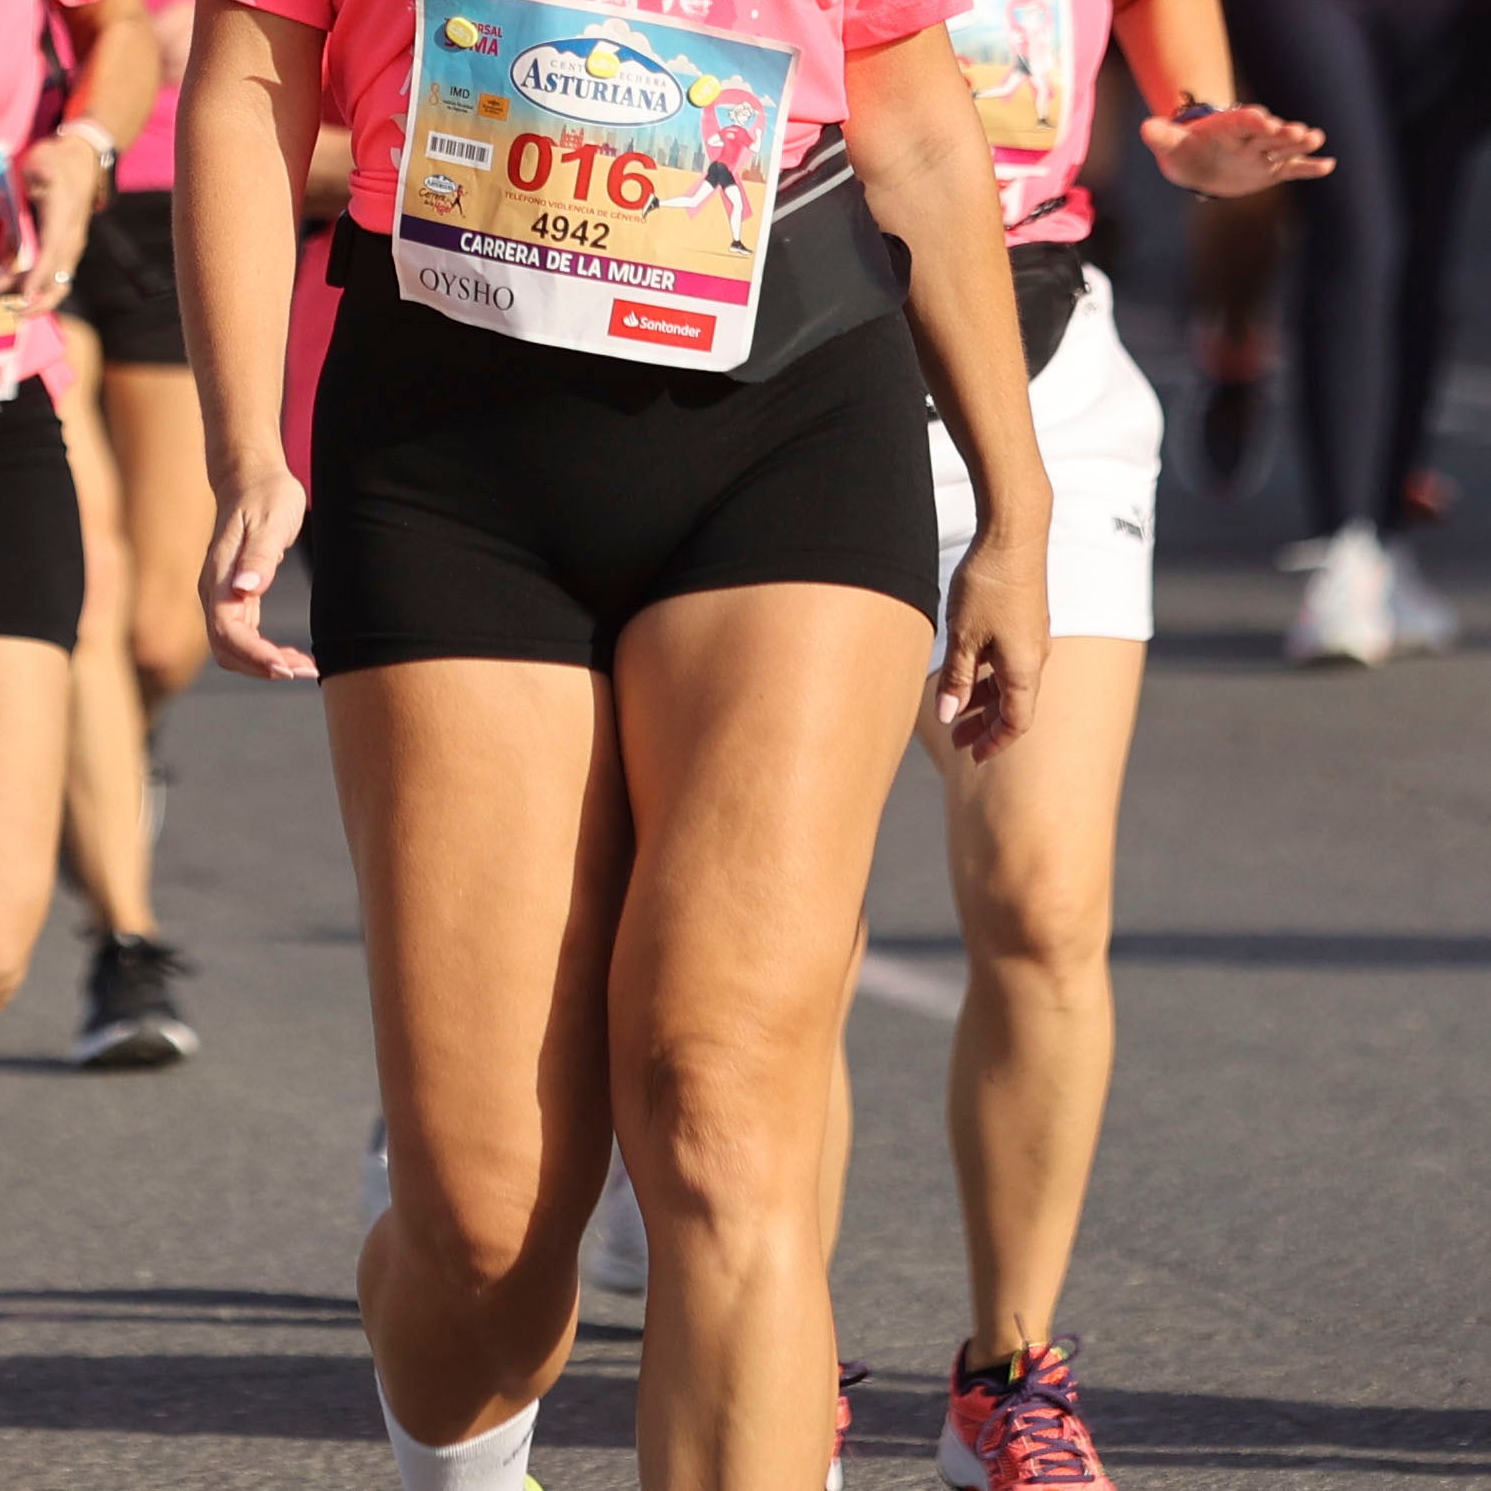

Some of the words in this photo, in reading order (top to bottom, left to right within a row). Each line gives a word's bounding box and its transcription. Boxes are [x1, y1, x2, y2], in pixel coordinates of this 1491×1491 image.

[450, 86, 471, 99] IMD
[521, 57, 669, 114] ASTURIANA
[507, 133, 658, 211] 016
[548, 200, 595, 216] VIOLENCIA
[597, 209, 608, 218] DE
[530, 212, 610, 250] 4942
[459, 232, 540, 267] CARRERA
[546, 250, 573, 273] DE
[577, 256, 602, 279] LA
[608, 261, 677, 291] MUJER
[419, 267, 516, 311] OYSHO
[639, 315, 702, 339] Santander
